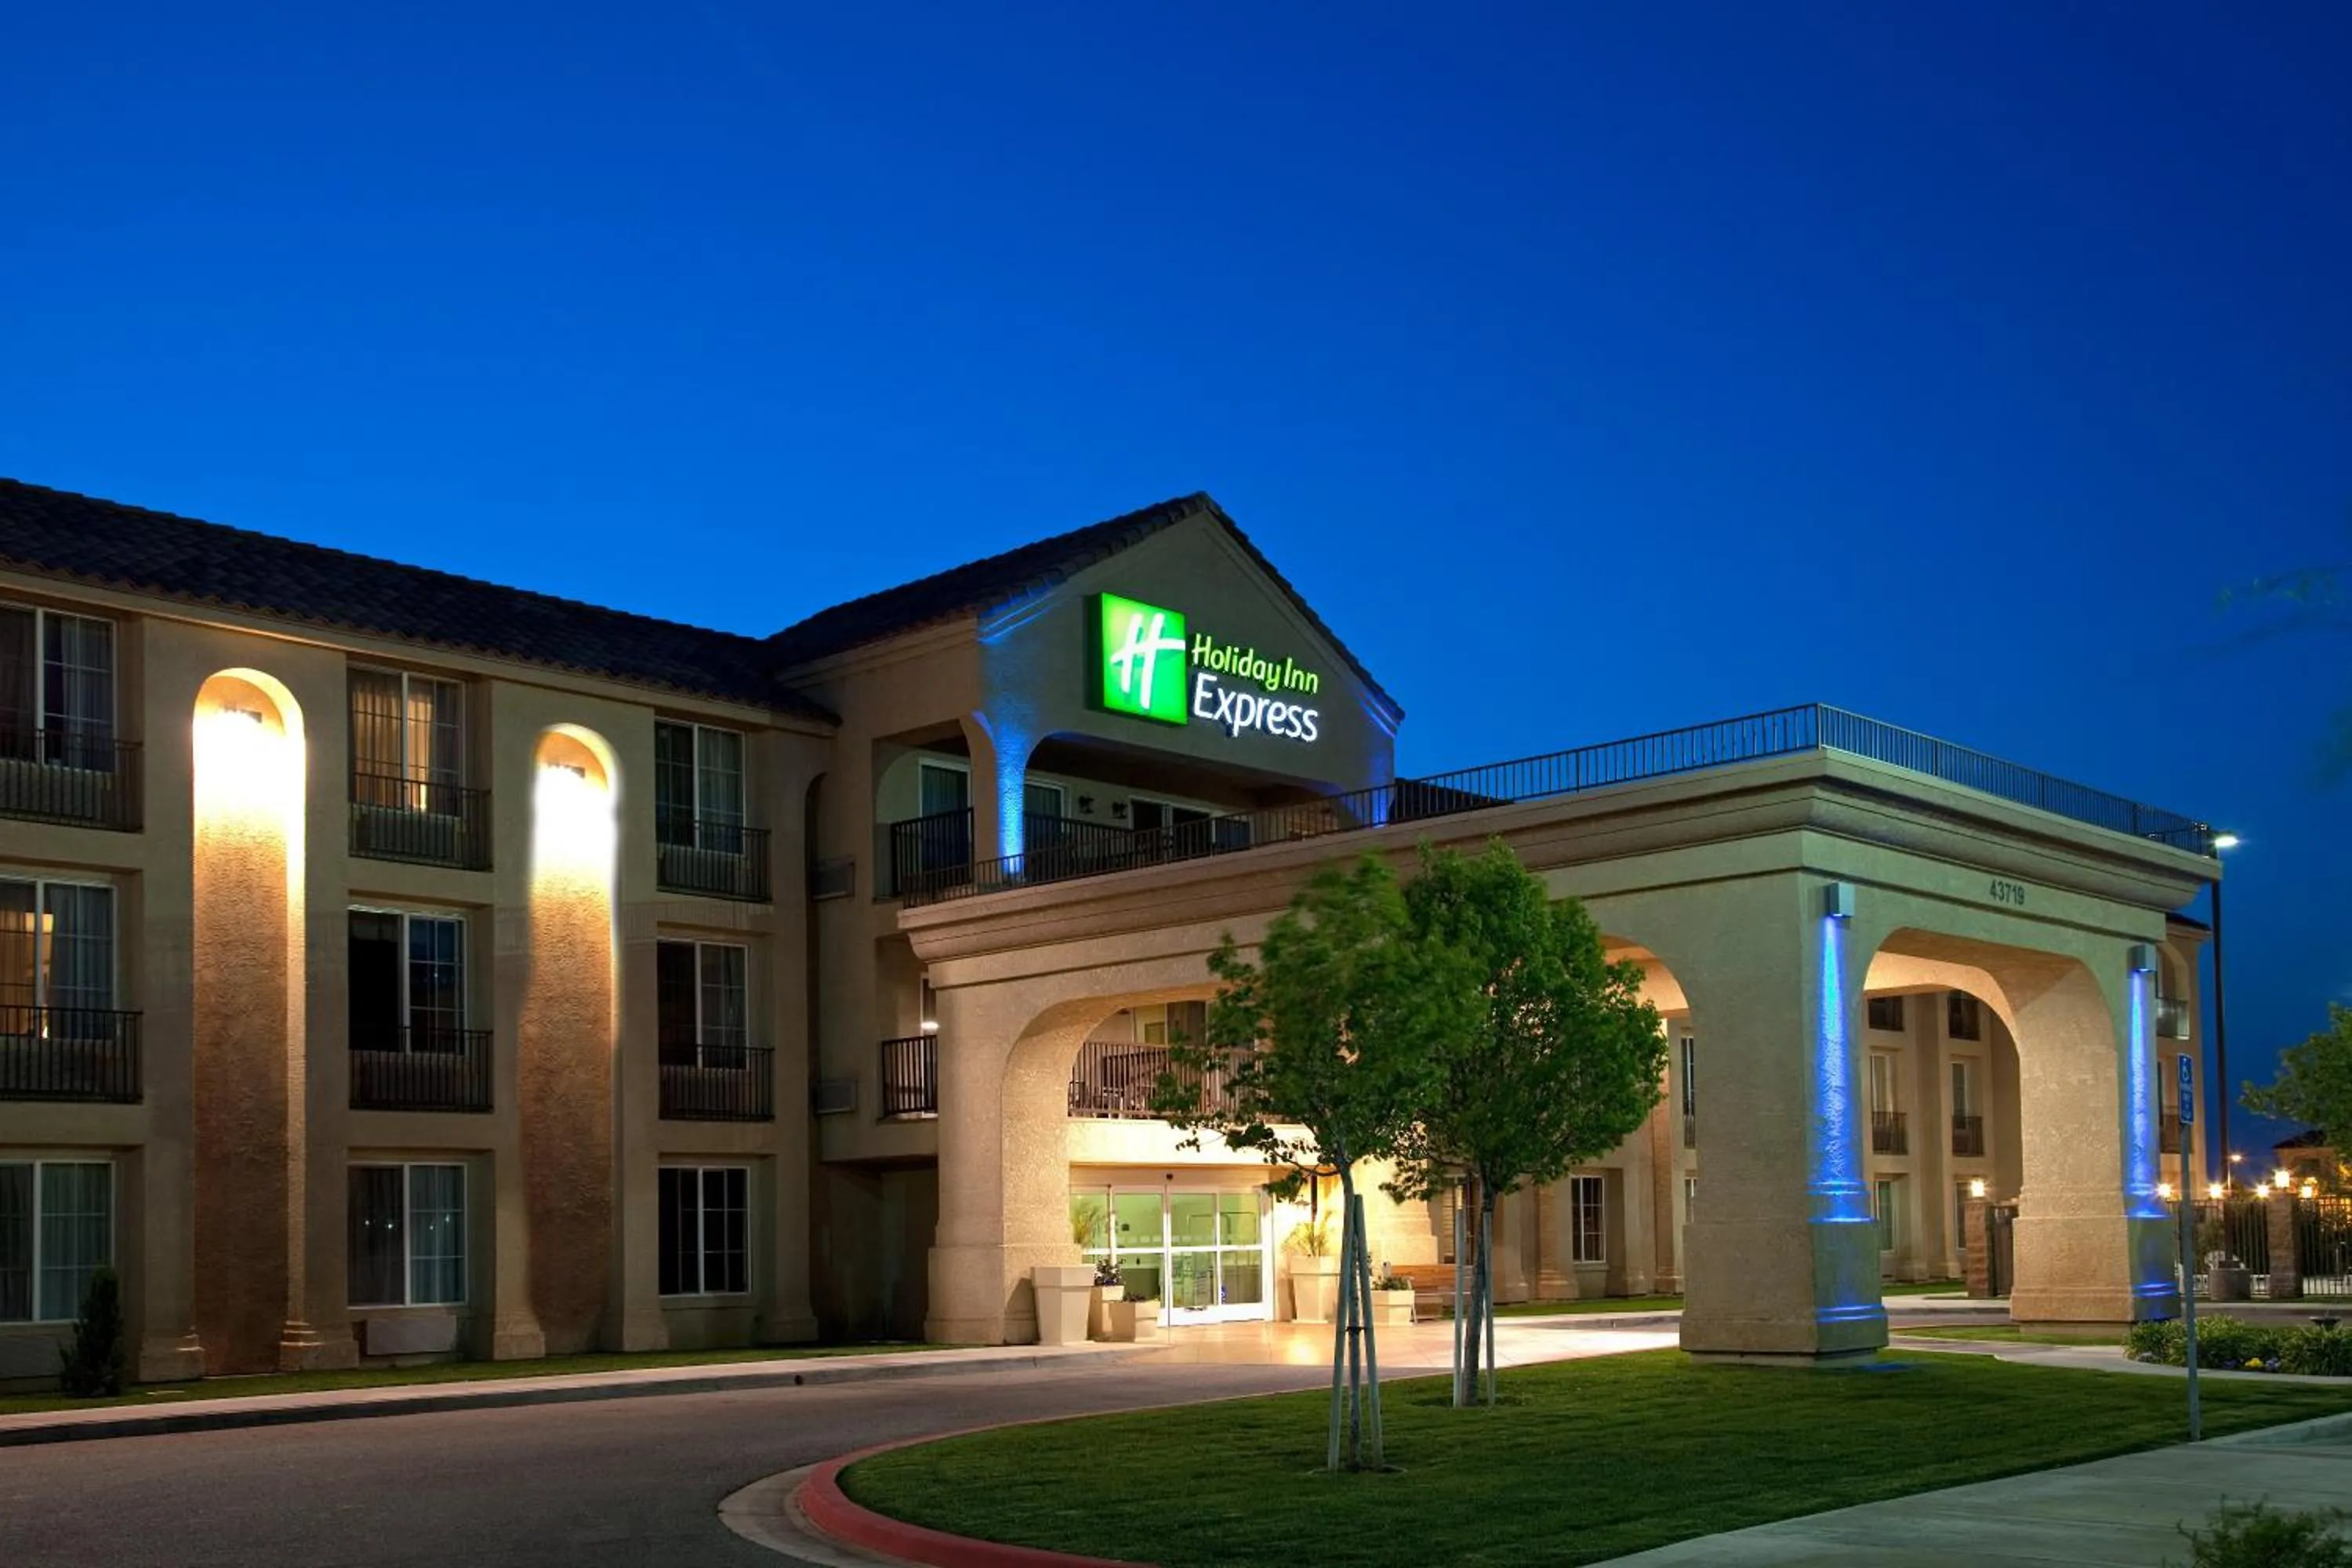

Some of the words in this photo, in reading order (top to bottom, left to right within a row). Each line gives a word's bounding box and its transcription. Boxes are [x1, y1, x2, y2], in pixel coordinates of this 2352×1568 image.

[1192, 633, 1281, 691] Holiday
[1283, 657, 1319, 695] Inn
[1193, 672, 1319, 742] Express
[1990, 879, 2025, 906] 43719
